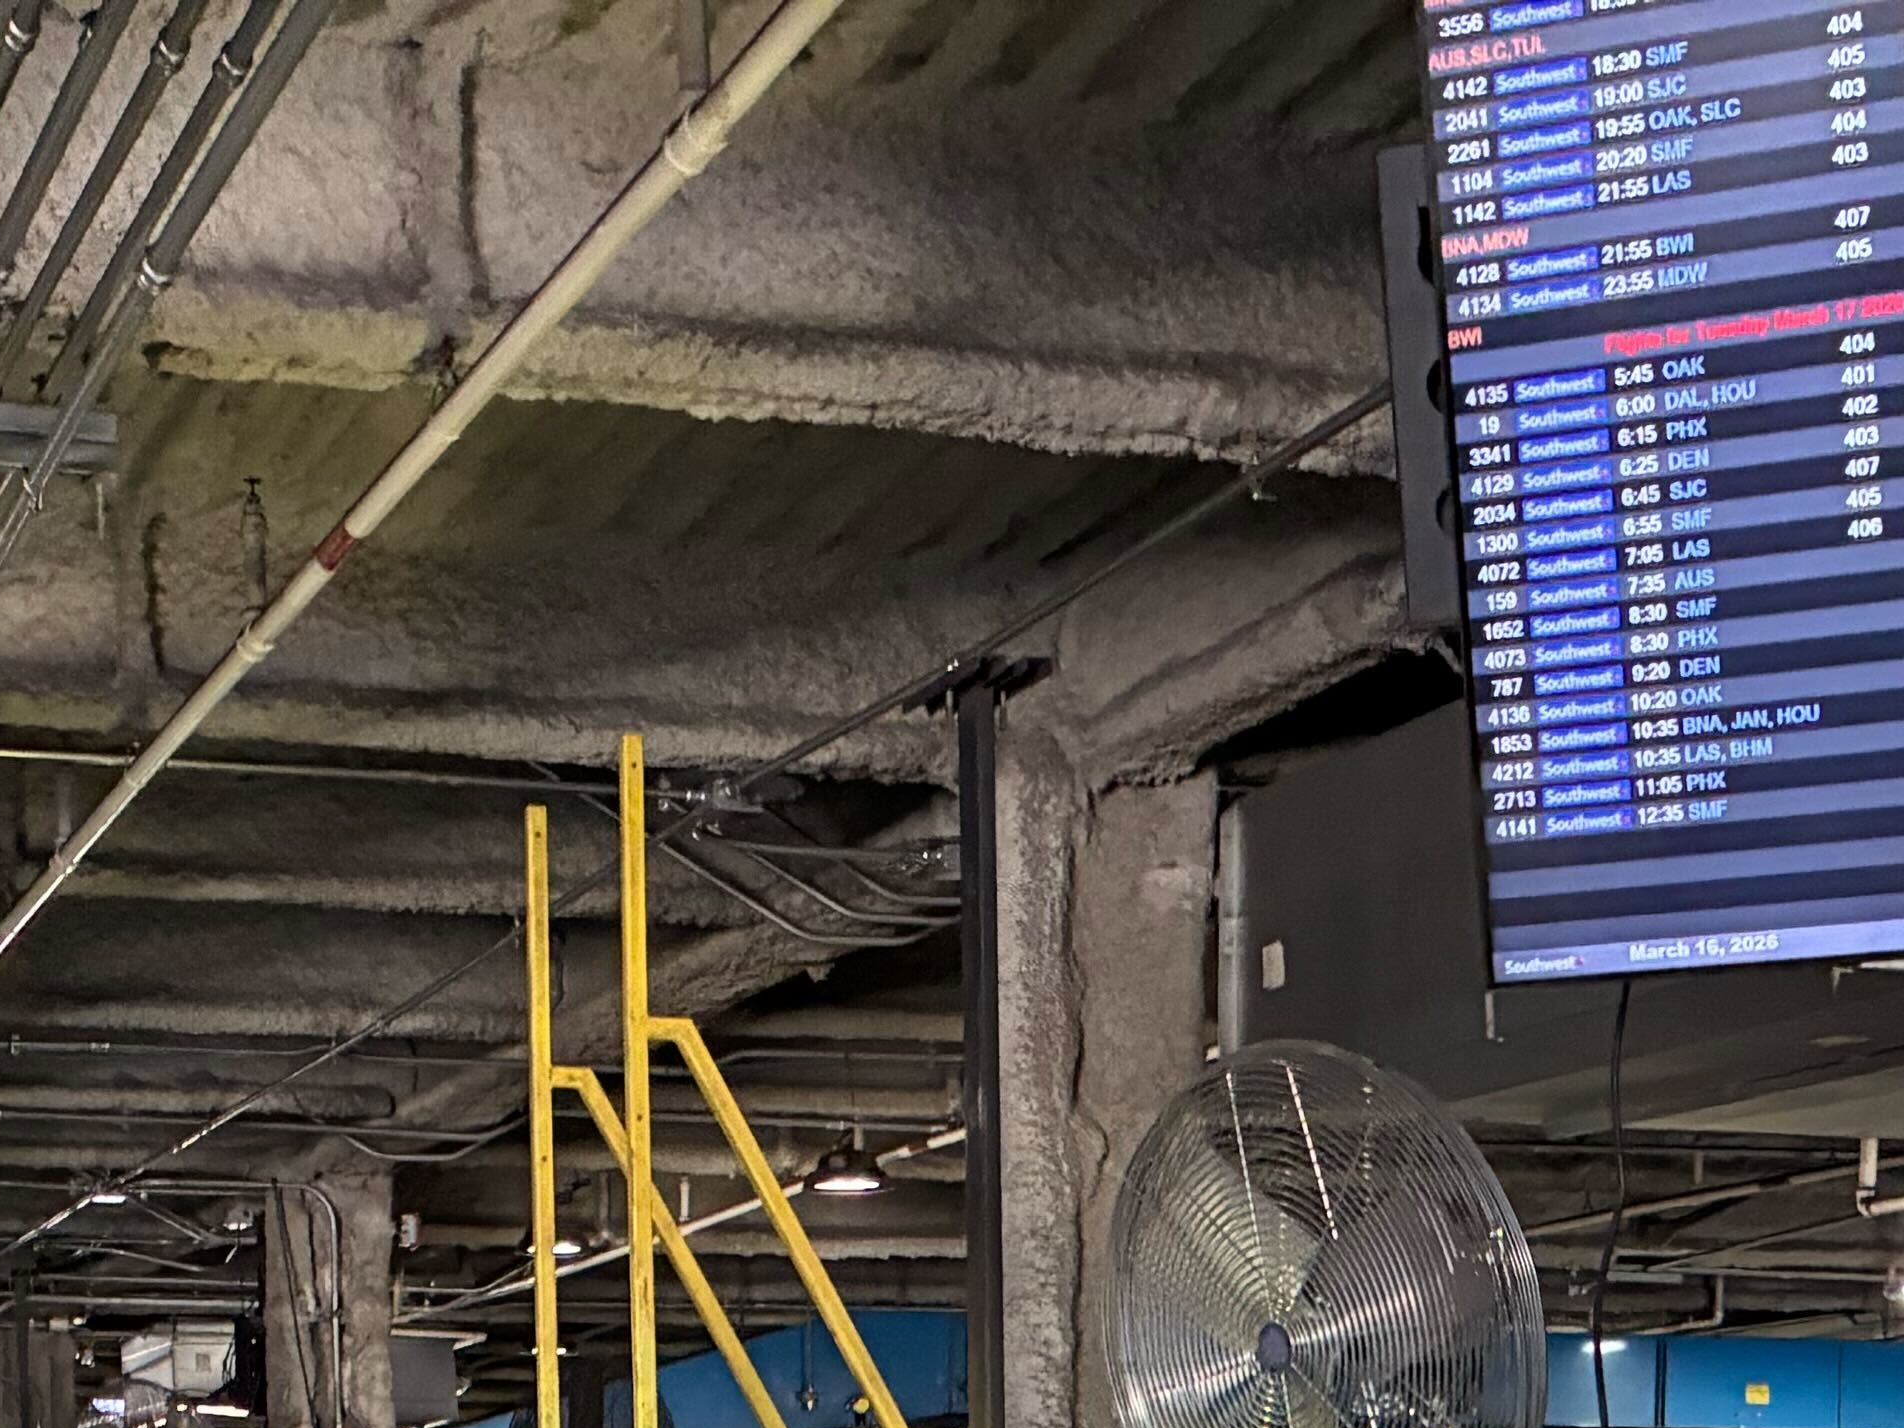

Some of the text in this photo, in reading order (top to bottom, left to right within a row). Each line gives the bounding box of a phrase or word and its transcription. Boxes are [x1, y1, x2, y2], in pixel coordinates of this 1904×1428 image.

[1438, 13, 1484, 38] 3556
[1492, 1, 1572, 29] Southwest
[1442, 11, 1863, 100] 4142 18:30 SMF 404
[1445, 108, 1488, 132] 2041
[1498, 97, 1577, 124] Southwest
[1594, 82, 1644, 107] 19:00
[1647, 75, 1687, 98] SJC
[1827, 44, 1866, 69] 405
[1595, 114, 1645, 139] 19:55
[1701, 98, 1741, 122] SLC
[1829, 78, 1866, 100] 403
[1451, 172, 1493, 194] 1104
[1596, 145, 1647, 171] 20:20
[1651, 138, 1693, 162] SMF
[1830, 110, 1867, 134] 404
[1452, 202, 1496, 225] 1142
[1504, 191, 1584, 219] Southwest
[1598, 177, 1648, 203] 21:55
[1652, 170, 1691, 193] LAS
[1832, 142, 1868, 165] 403
[1456, 263, 1500, 286] 4128
[1601, 239, 1652, 265] 21:55
[1656, 233, 1694, 257] BWI
[1834, 206, 1870, 229] 407
[1458, 294, 1501, 317] 4134
[1511, 282, 1589, 309] Southwest
[1603, 270, 1654, 297] 23:55
[1835, 238, 1873, 262] 405
[1448, 327, 1482, 350] BWI
[1465, 386, 1508, 407] 4135
[1614, 363, 1654, 386] 5:45
[1662, 355, 1705, 378] OAK
[1839, 331, 1876, 355] 404
[1469, 443, 1511, 466] 3341
[1617, 424, 1657, 447] 6:15
[1666, 417, 1706, 440] PHX
[1841, 394, 1878, 417] 402
[1479, 415, 1500, 435] 19
[1519, 402, 1596, 430] Southwest
[1616, 393, 1655, 416] 6:00
[1712, 379, 1756, 404] HOU
[1840, 363, 1875, 386] 401
[1471, 473, 1514, 496] 4129
[1619, 455, 1658, 477] 6:25
[1668, 449, 1709, 471] DEN
[1843, 425, 1880, 448] 403
[1473, 502, 1516, 526] 2034
[1524, 492, 1602, 519] Southwest
[1621, 484, 1661, 506] 6:45
[1669, 478, 1707, 500] SJC
[1844, 455, 1880, 478] 407
[1477, 532, 1518, 554] 1300
[1623, 514, 1662, 536] 6:55
[1671, 507, 1711, 531] SMF
[1845, 486, 1882, 508] 405
[1477, 561, 1520, 583] 4072
[1625, 543, 1664, 565] 7:05
[1672, 538, 1710, 560] LAS
[1847, 517, 1883, 539] 406
[1486, 590, 1517, 612] 159
[1531, 583, 1608, 607] Southwest
[1628, 573, 1665, 595] 7:35
[1674, 568, 1715, 590] AUS
[1676, 597, 1717, 618] SMF
[1484, 648, 1526, 669] 4073
[1678, 626, 1718, 648] PHX
[1537, 670, 1614, 694] Southwest
[1632, 660, 1670, 682] 9:20
[1680, 655, 1720, 678] DEN
[1488, 705, 1530, 726] 4136
[1631, 689, 1677, 712] 10:20
[1681, 685, 1723, 706] OAK
[1491, 733, 1533, 754] 1853
[1633, 718, 1679, 740] 10:35
[1777, 703, 1820, 725] HOU
[1492, 761, 1534, 782] 4212
[1541, 753, 1619, 778] Southwest
[1635, 747, 1681, 768] 10:35
[1730, 737, 1773, 758] BHM
[1494, 790, 1536, 811] 2713
[1636, 775, 1683, 796] 11:05
[1687, 770, 1725, 792] PHX
[1496, 818, 1536, 837] 4141
[1638, 803, 1684, 825] 12:35
[1688, 799, 1728, 819] SMF
[1505, 953, 1576, 975] Southwest
[1630, 942, 1690, 961] March
[1730, 933, 1779, 953] 2026
